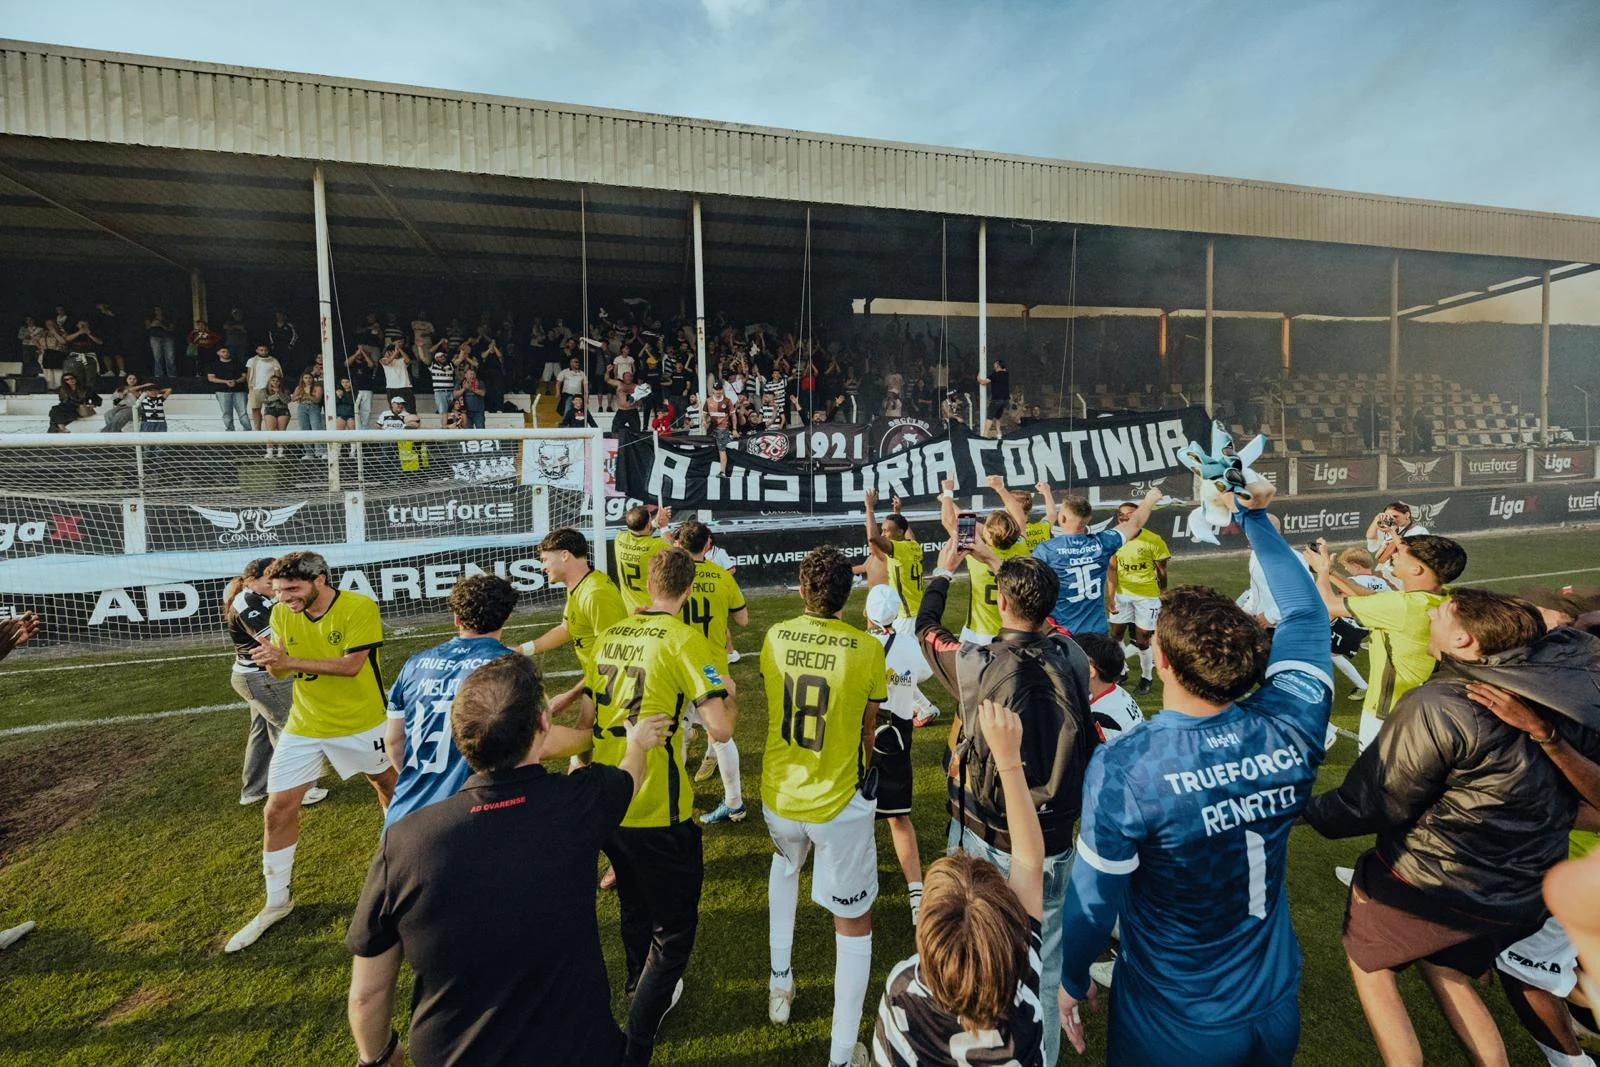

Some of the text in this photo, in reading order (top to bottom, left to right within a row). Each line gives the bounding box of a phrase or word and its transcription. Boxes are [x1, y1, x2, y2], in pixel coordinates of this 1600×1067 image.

[795, 431, 863, 460] 1921
[619, 561, 643, 592] 12
[1065, 563, 1102, 604] 36
[88, 583, 200, 626] AD
[681, 596, 714, 640] 14
[777, 629, 858, 649] TRUEFORCE
[785, 649, 837, 671] BREDA
[781, 671, 831, 753] 18
[406, 700, 453, 774] 13
[1164, 744, 1303, 795] TRUEFORCE
[1201, 785, 1297, 837] RENATO
[1245, 829, 1267, 920] 1
